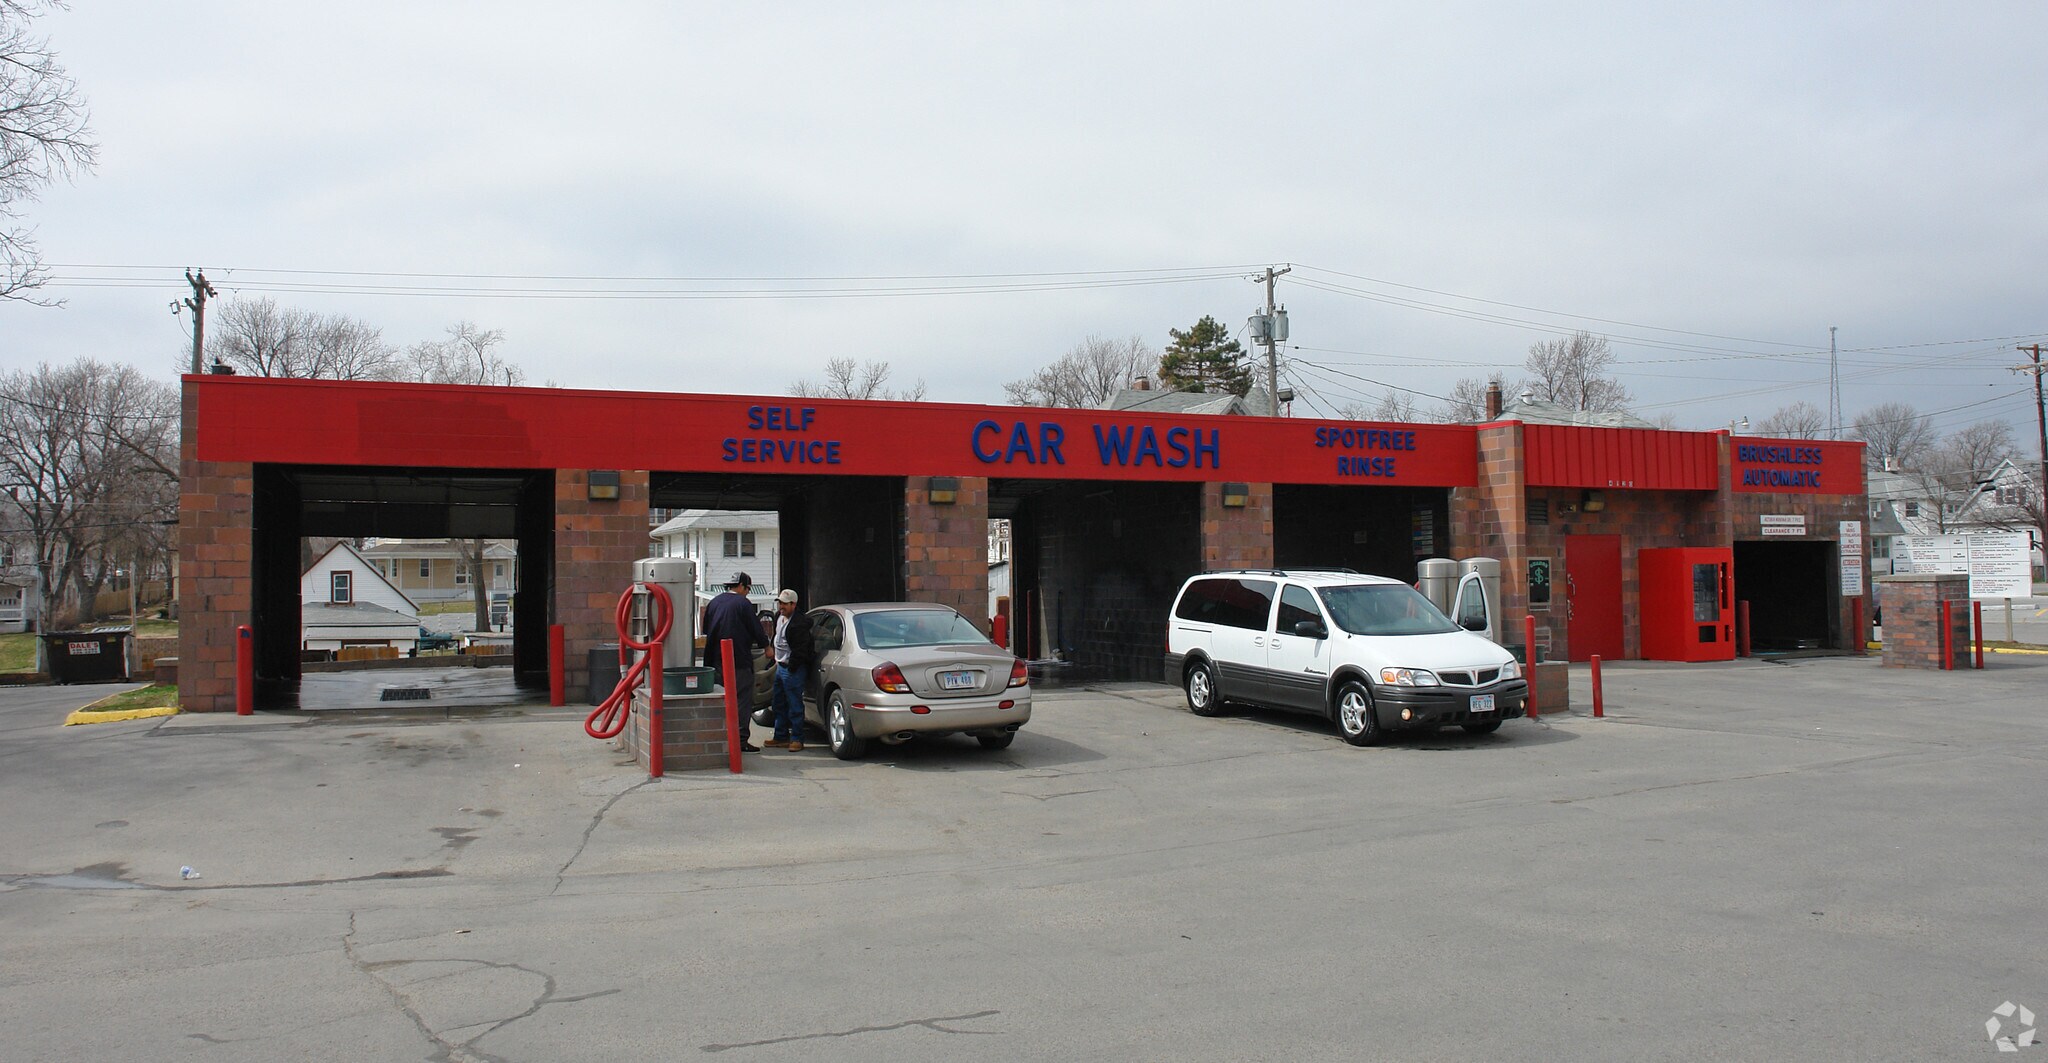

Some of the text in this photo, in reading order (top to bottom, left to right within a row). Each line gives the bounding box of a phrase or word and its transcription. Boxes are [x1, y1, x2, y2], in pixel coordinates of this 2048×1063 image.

[748, 406, 816, 431] SELF
[971, 419, 1221, 469] CAR WASH
[1315, 426, 1416, 451] SPOTFREE
[722, 438, 841, 464] SERVICE
[1737, 443, 1823, 465] BRUSHLESS
[1337, 455, 1397, 478] RINSE
[1743, 467, 1821, 488] AUTOMATIC
[649, 569, 655, 578] 4
